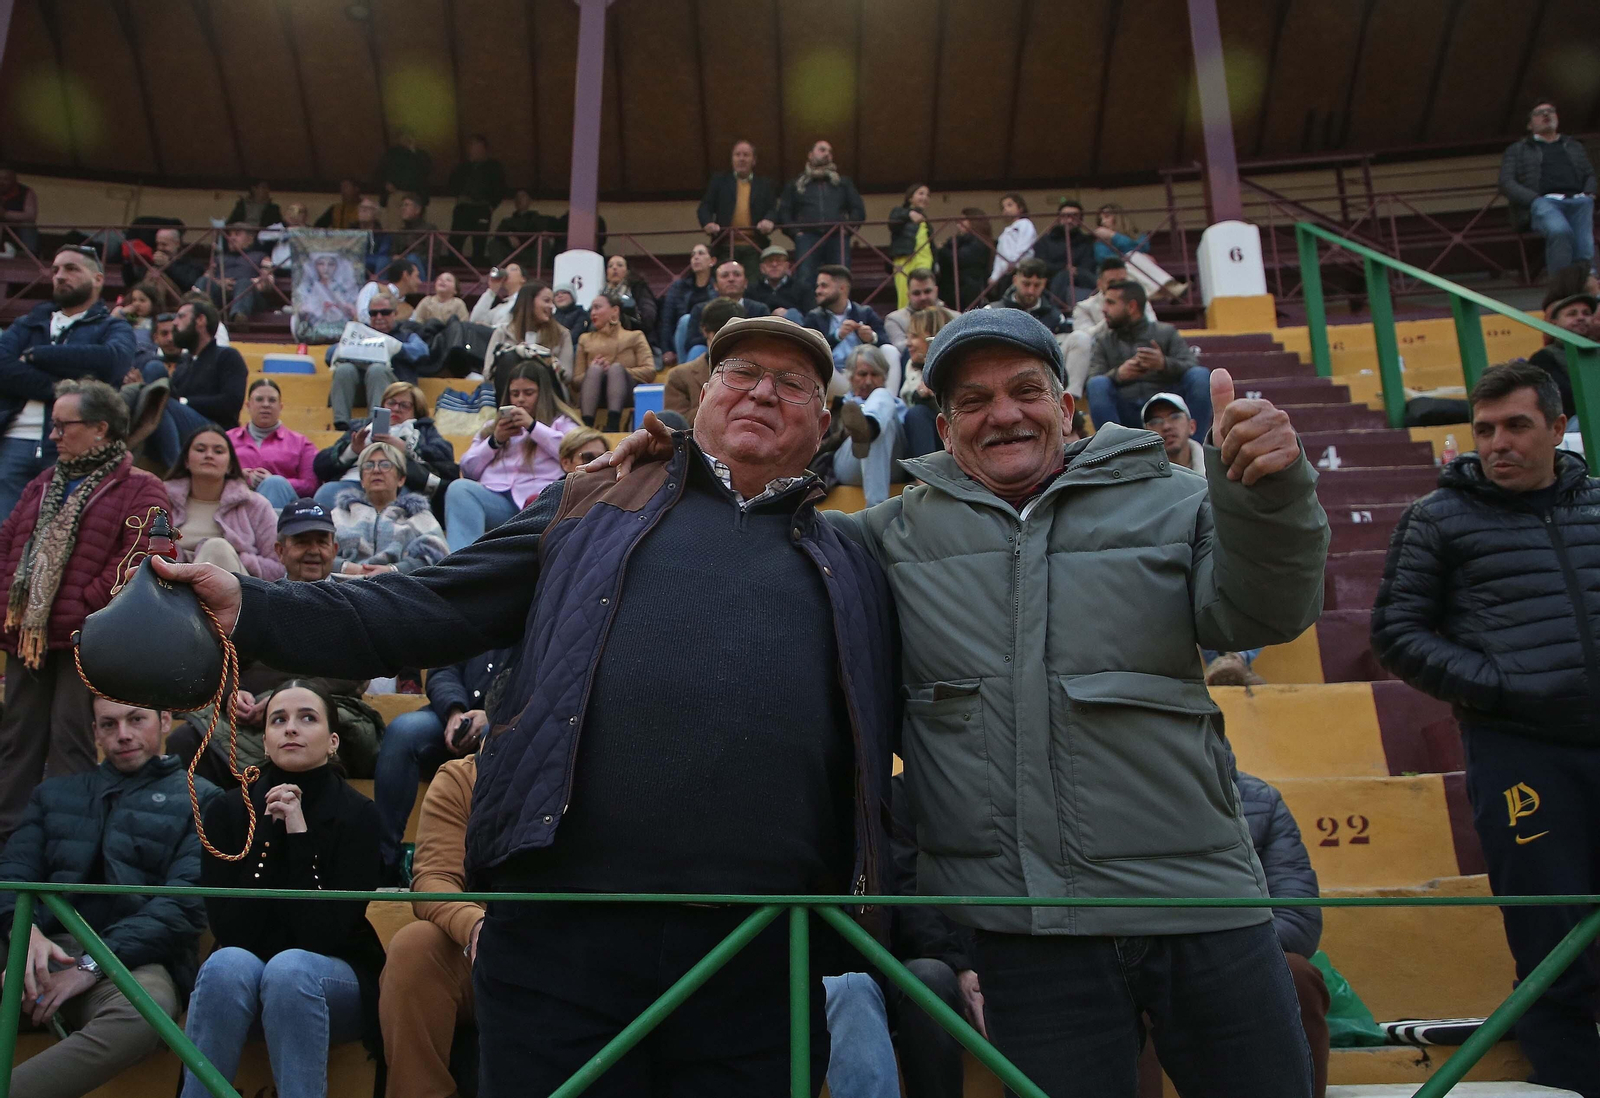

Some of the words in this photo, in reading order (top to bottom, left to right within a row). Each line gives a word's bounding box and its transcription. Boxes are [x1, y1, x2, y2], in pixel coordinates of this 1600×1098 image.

[1230, 246, 1244, 262] 6
[1317, 445, 1342, 471] 4
[1316, 814, 1370, 847] 22
